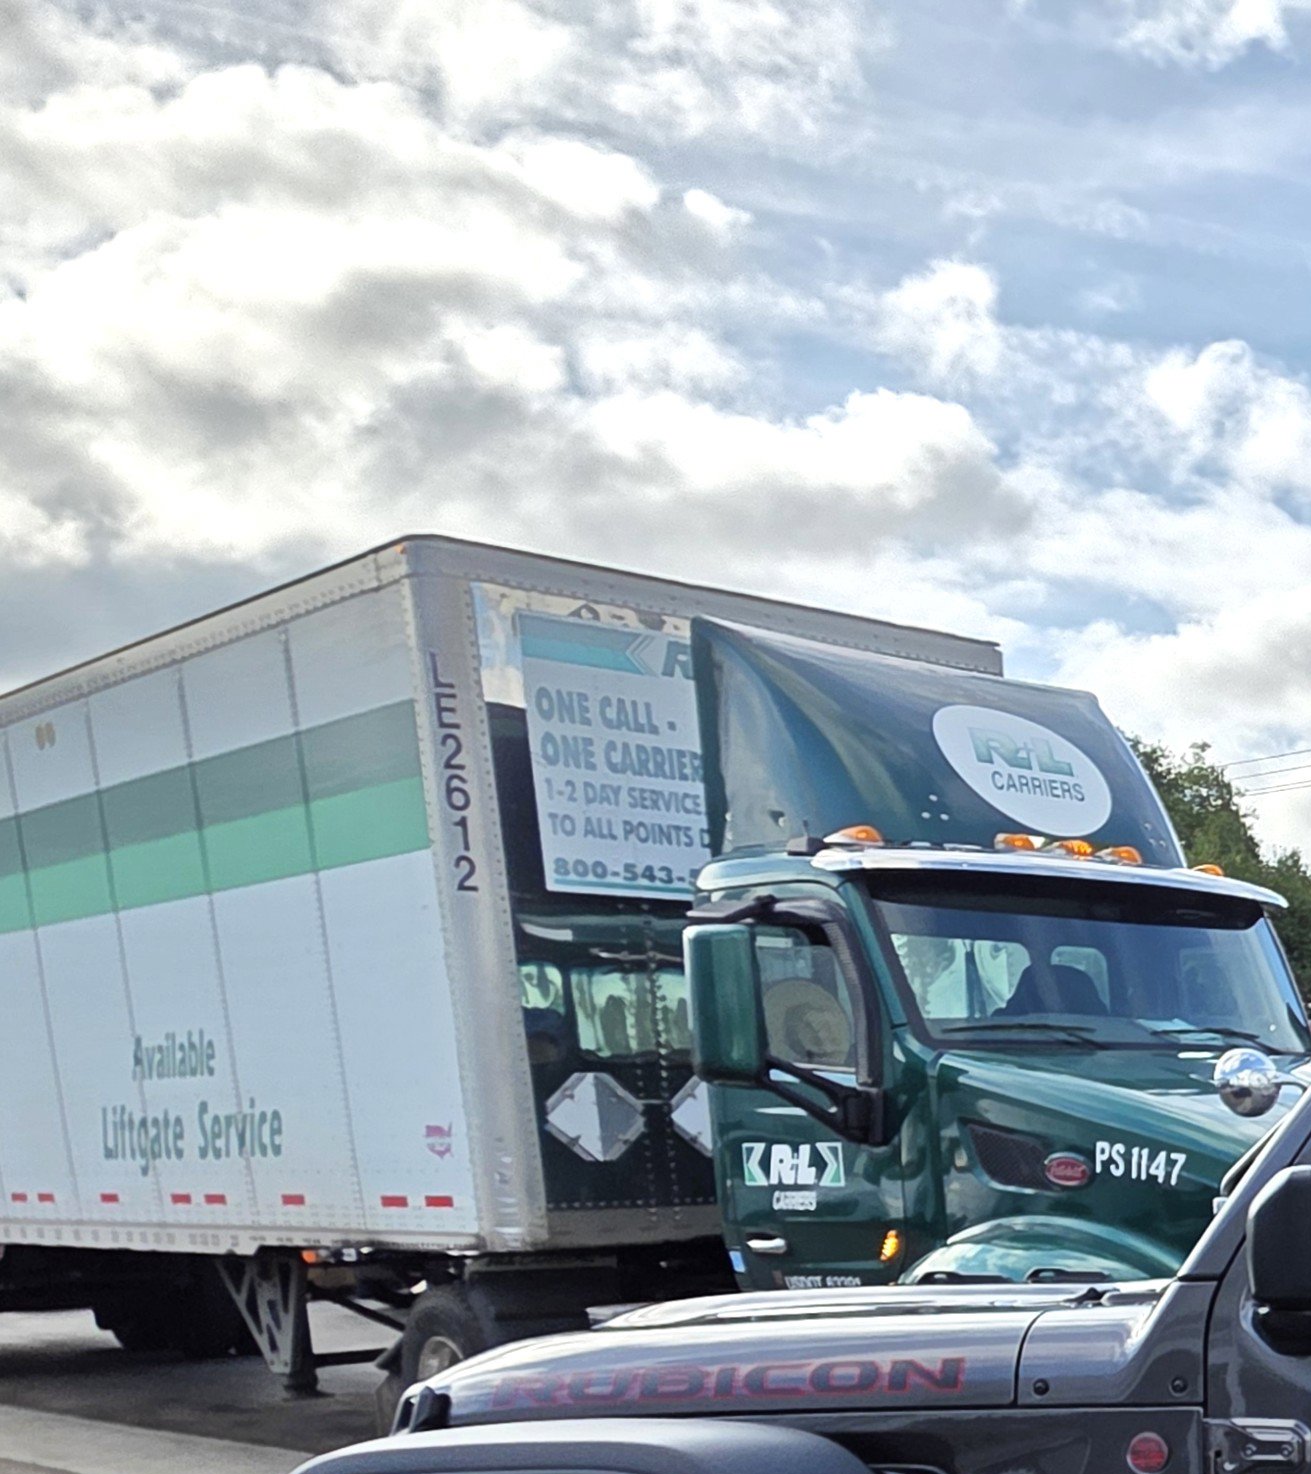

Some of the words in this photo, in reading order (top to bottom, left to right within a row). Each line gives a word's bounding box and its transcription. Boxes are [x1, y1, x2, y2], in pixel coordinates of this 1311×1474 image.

[534, 686, 592, 727] ONE
[599, 695, 660, 736] CALL
[430, 651, 479, 892] LE2612
[540, 731, 597, 771] ONE
[545, 777, 577, 803] 1-2
[583, 781, 622, 807] DAY
[627, 786, 703, 816] SERVICE
[991, 770, 1085, 802] CARRIERS
[548, 812, 577, 837] TO
[583, 817, 618, 842] ALL
[622, 820, 694, 848] POINTS
[132, 1027, 216, 1082] Available
[102, 1104, 185, 1177] Liftgate
[197, 1097, 283, 1160] Service
[491, 1357, 967, 1411] RUBICON
